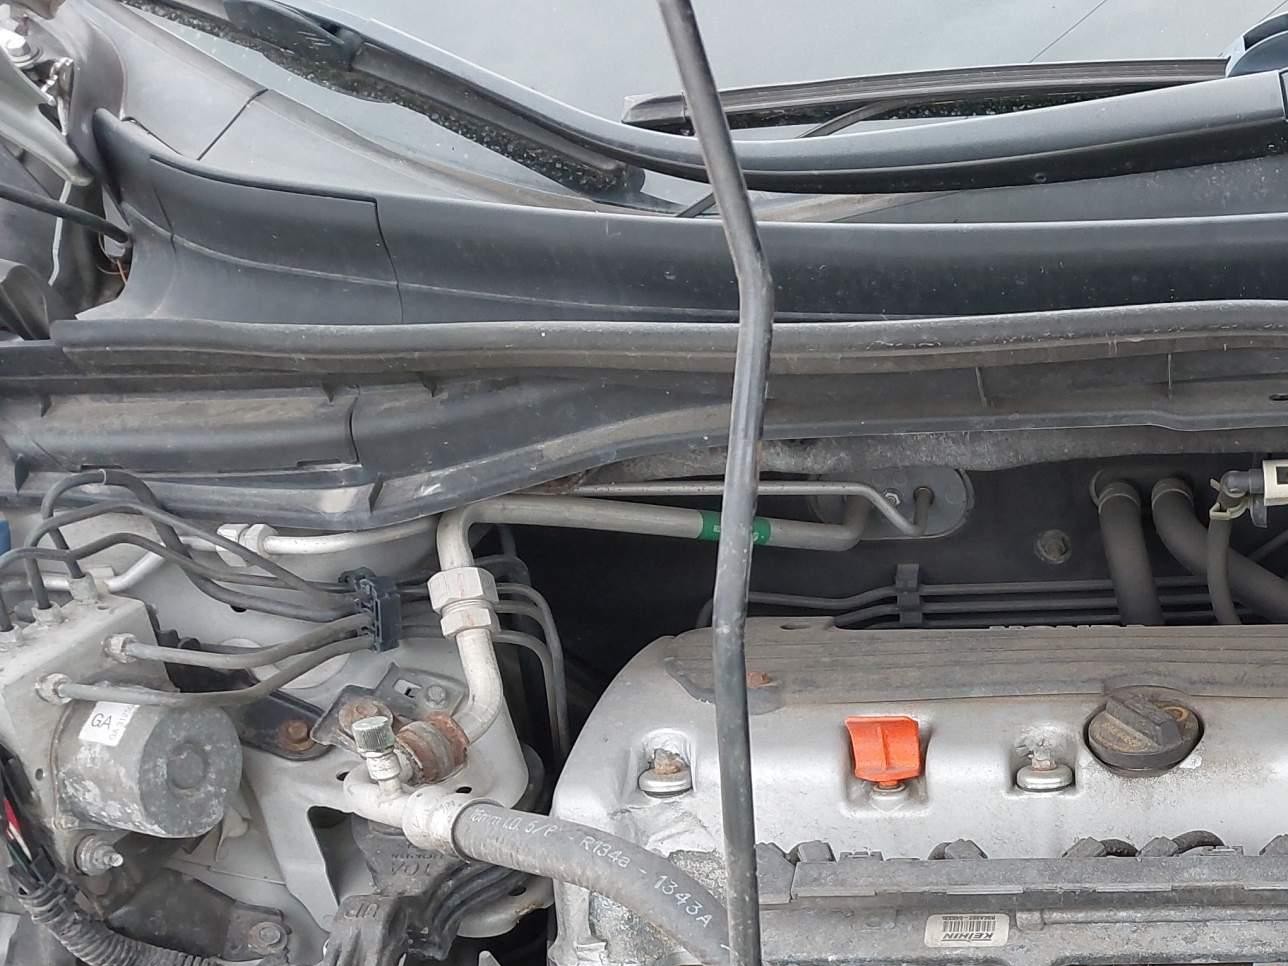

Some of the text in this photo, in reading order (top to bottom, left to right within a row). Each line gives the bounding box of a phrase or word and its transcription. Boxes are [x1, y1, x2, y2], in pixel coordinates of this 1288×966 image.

[91, 713, 112, 728] GA
[578, 835, 632, 869] R134a
[653, 874, 714, 929] 1343A
[943, 932, 994, 941] KEIHIN
